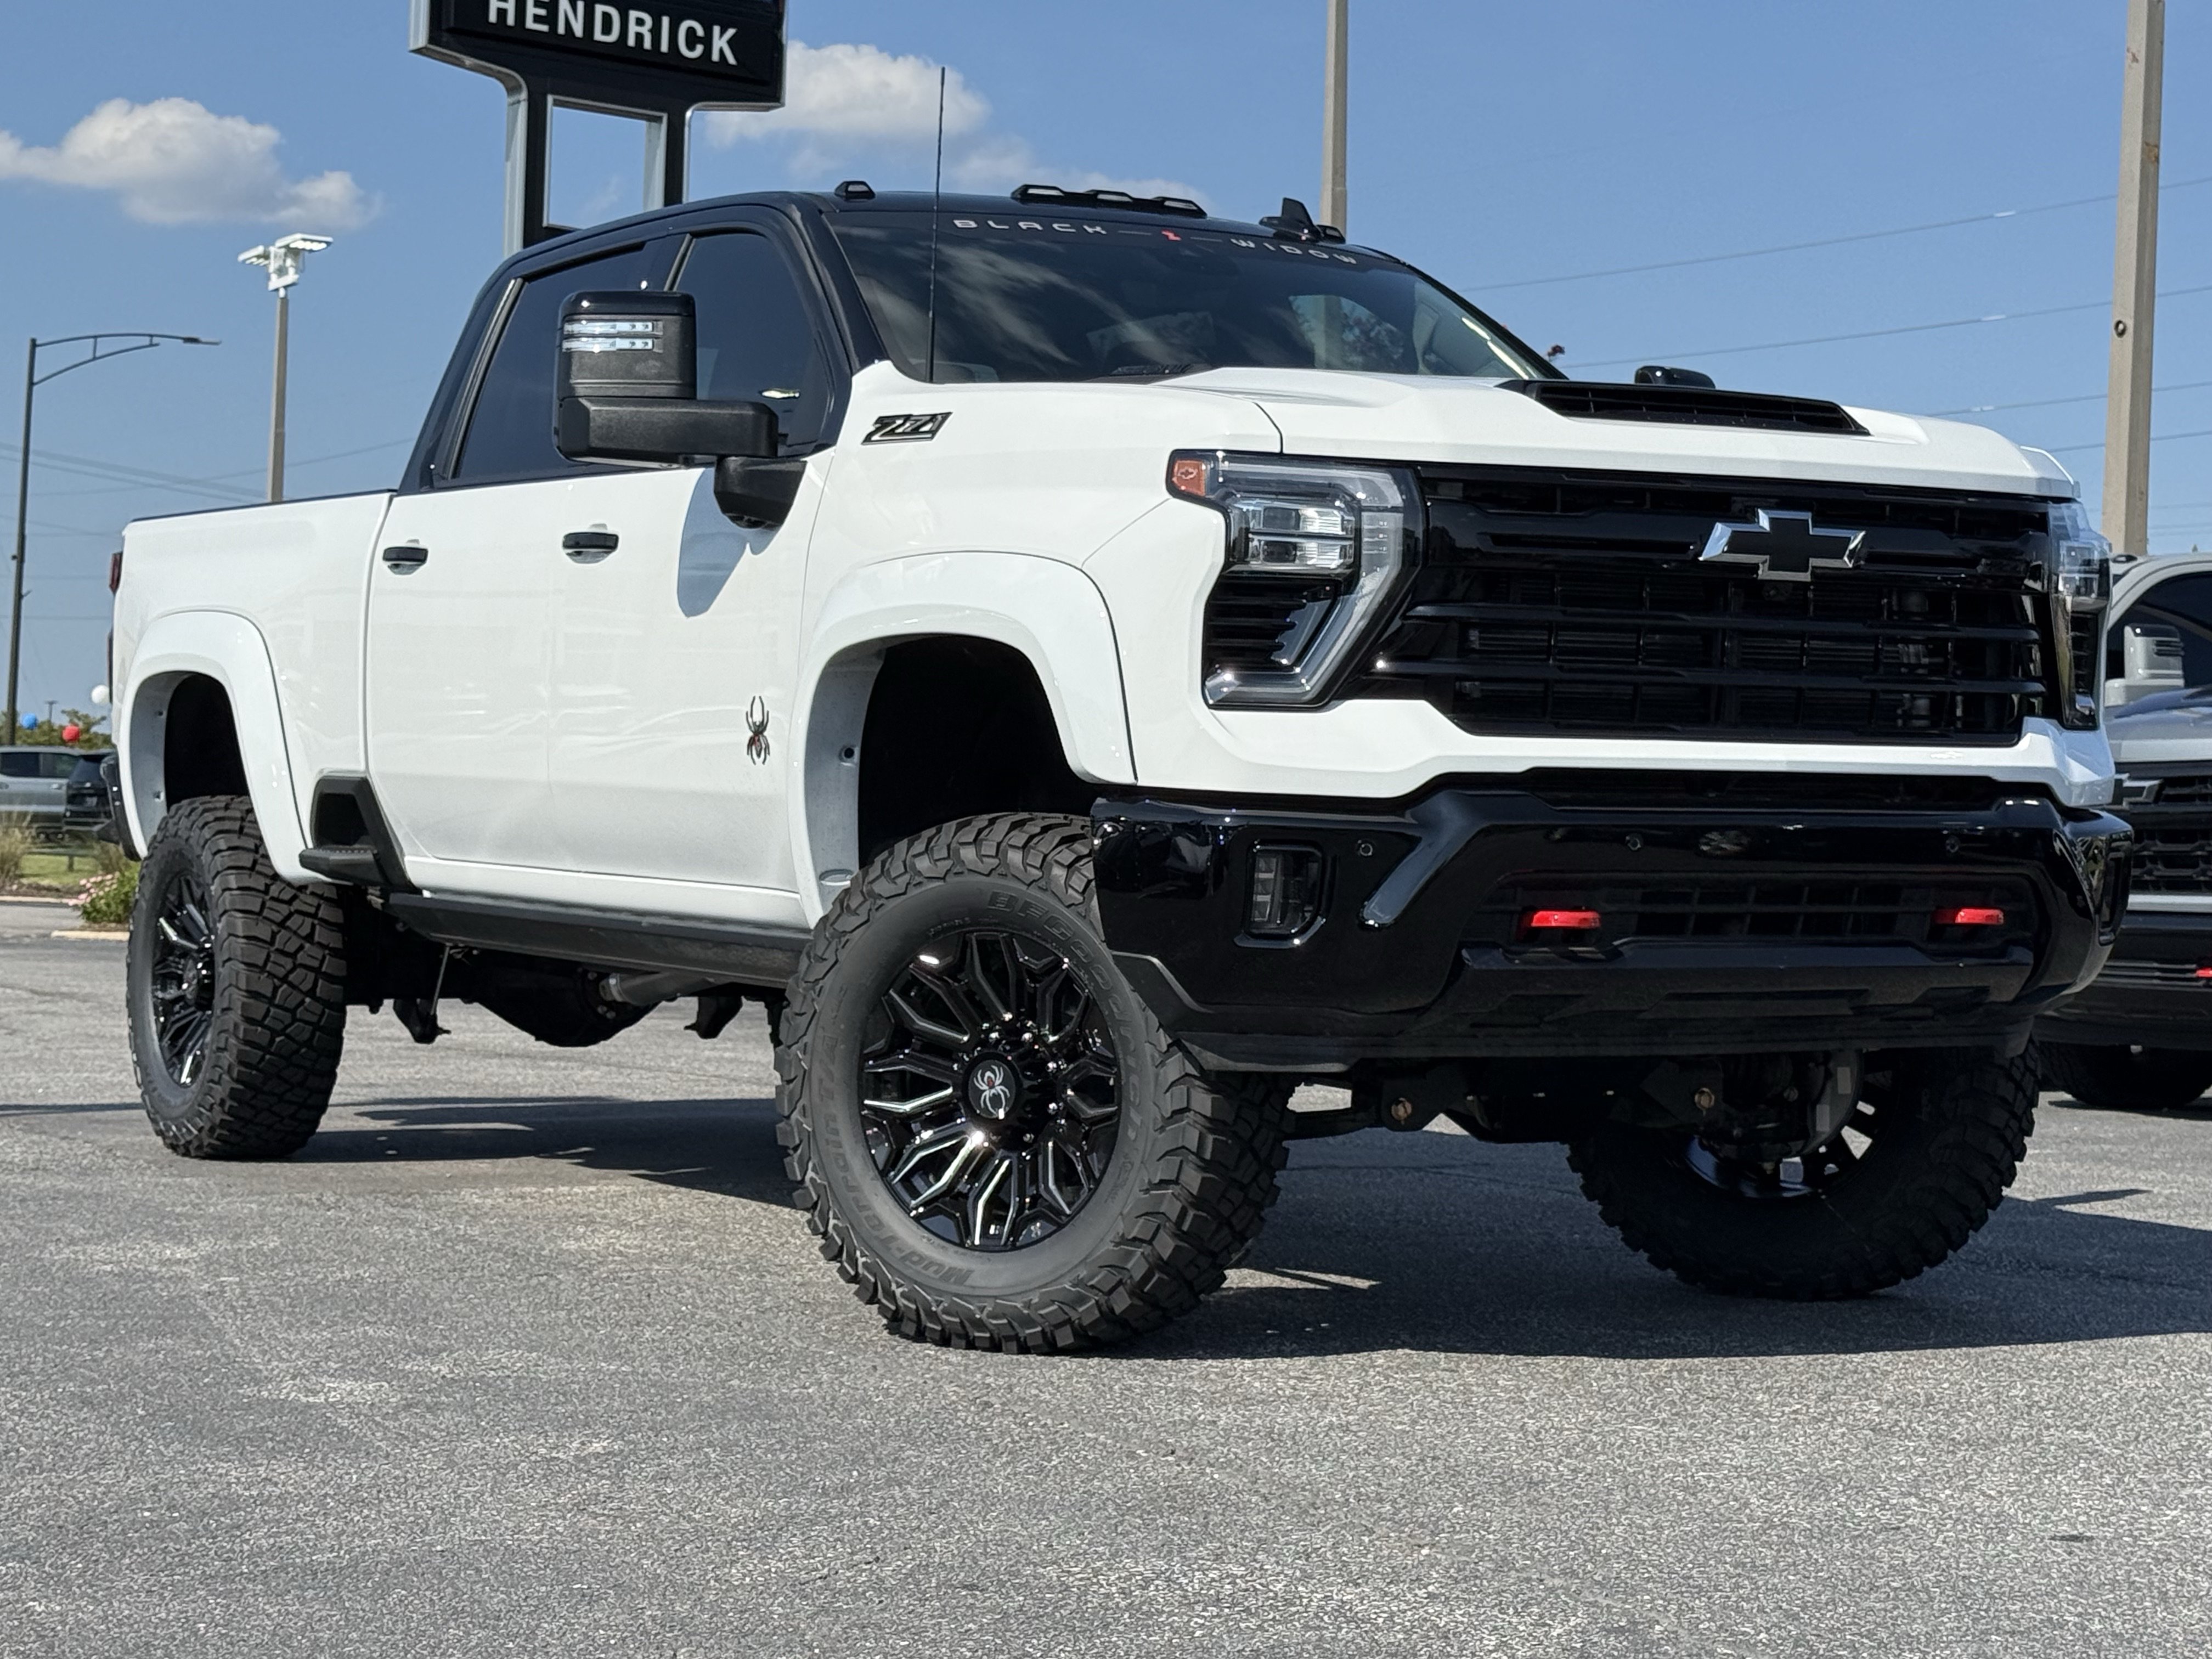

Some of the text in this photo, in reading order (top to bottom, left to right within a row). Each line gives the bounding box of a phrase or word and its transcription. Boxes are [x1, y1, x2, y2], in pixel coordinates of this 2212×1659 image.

[488, 0, 738, 65] HENDRICK
[953, 219, 1357, 264] BLACK WIDOW
[862, 413, 951, 445] Z71
